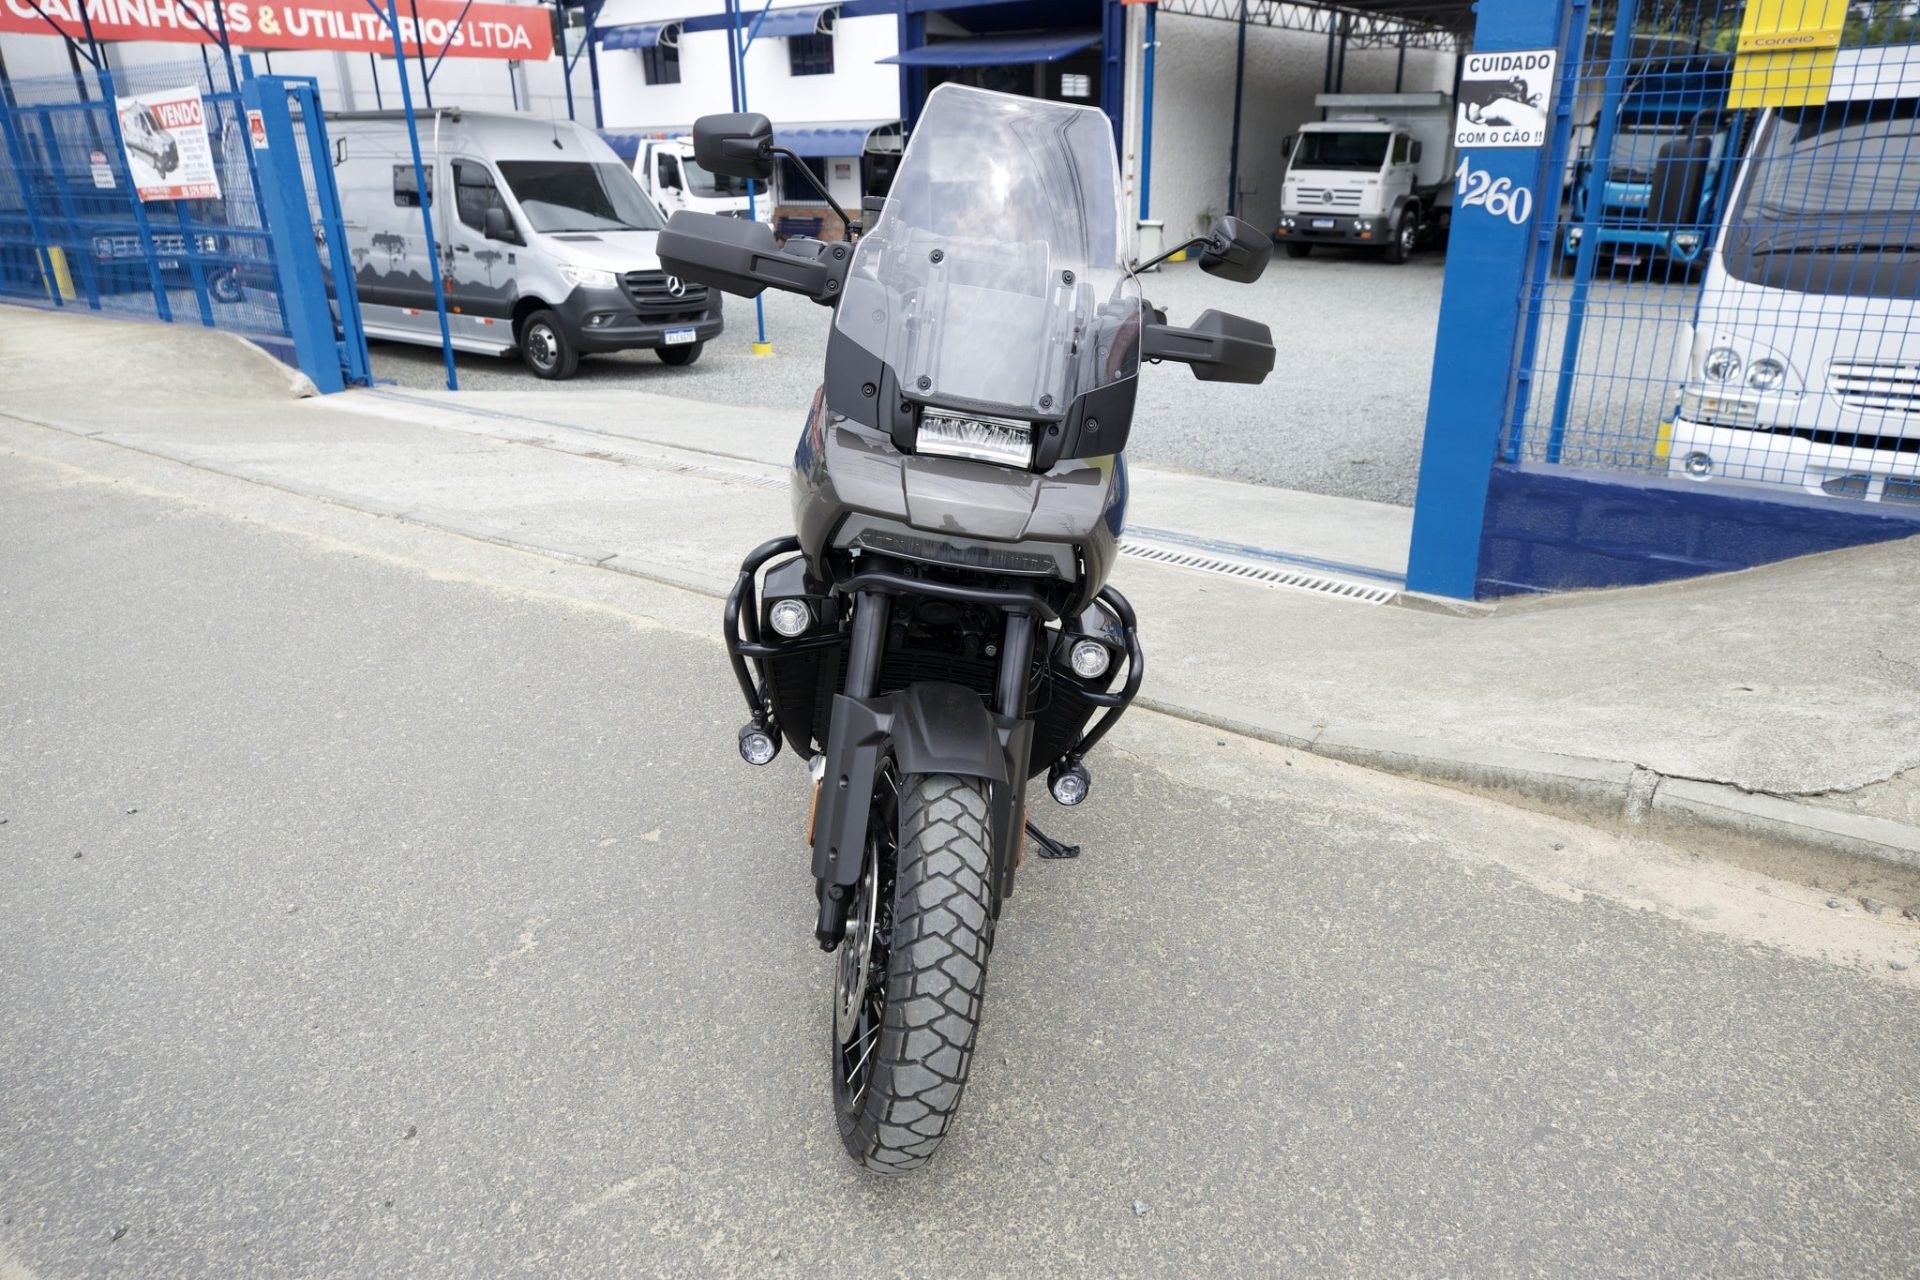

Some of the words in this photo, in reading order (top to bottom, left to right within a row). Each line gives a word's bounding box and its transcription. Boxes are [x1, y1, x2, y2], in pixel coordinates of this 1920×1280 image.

[258, 6, 281, 35] &
[468, 21, 532, 49] LTDA
[1470, 54, 1550, 73] CUIDADO
[157, 101, 200, 127] VENDO
[1458, 131, 1485, 143] COM
[1490, 131, 1499, 143] O
[1503, 129, 1530, 142] CÃO
[1455, 156, 1532, 225] 1260
